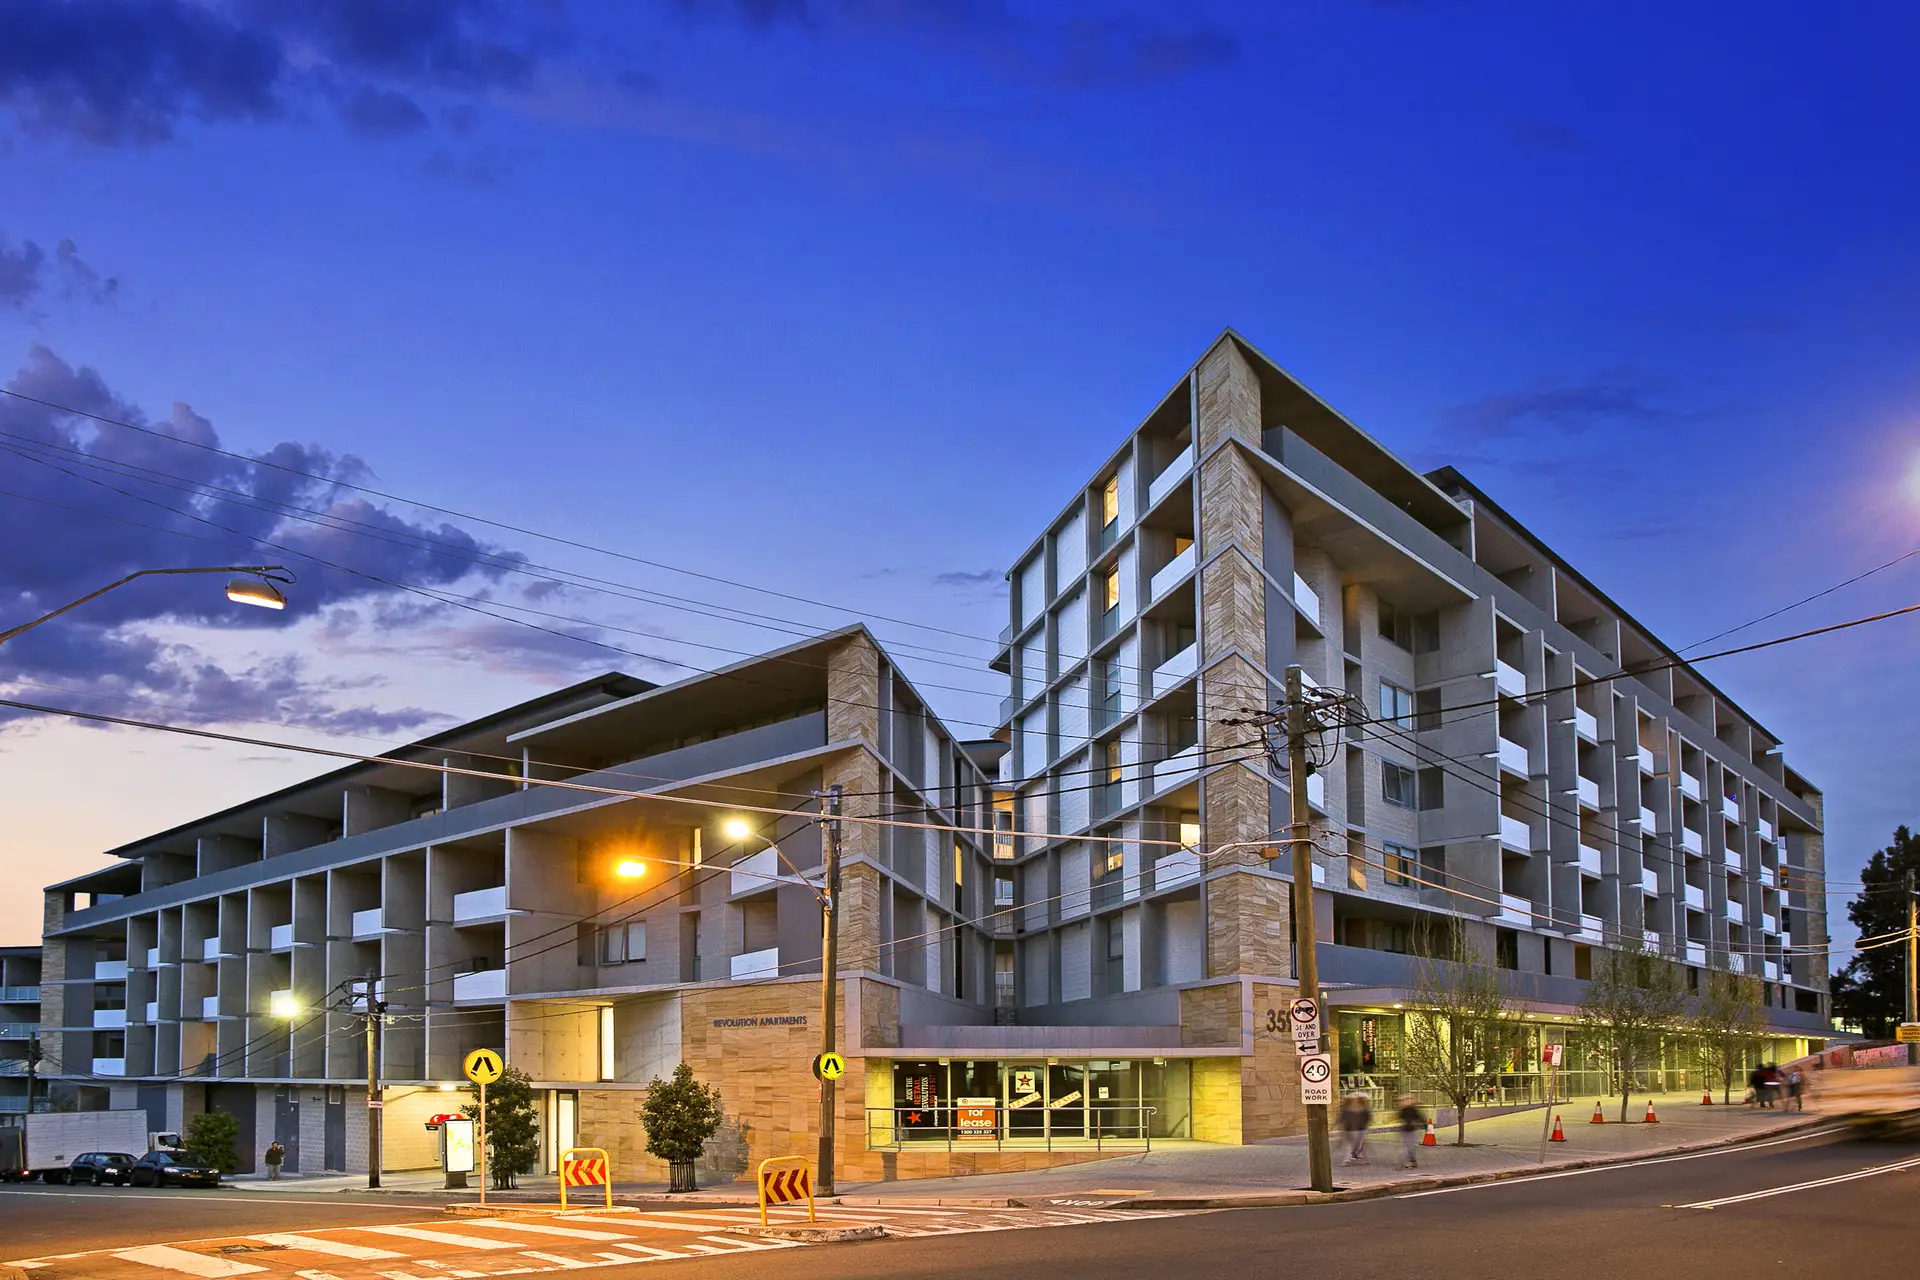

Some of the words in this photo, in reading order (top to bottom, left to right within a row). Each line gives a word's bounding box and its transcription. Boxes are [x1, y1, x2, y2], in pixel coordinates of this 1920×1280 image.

[712, 1018, 757, 1028] REVOLUTION
[759, 1016, 807, 1027] APARTMENTS
[1297, 1030, 1315, 1038] OVER
[1306, 1064, 1327, 1077] 40
[905, 1076, 913, 1088] THE
[905, 1088, 913, 1101] JOIN
[960, 1118, 993, 1127] lease
